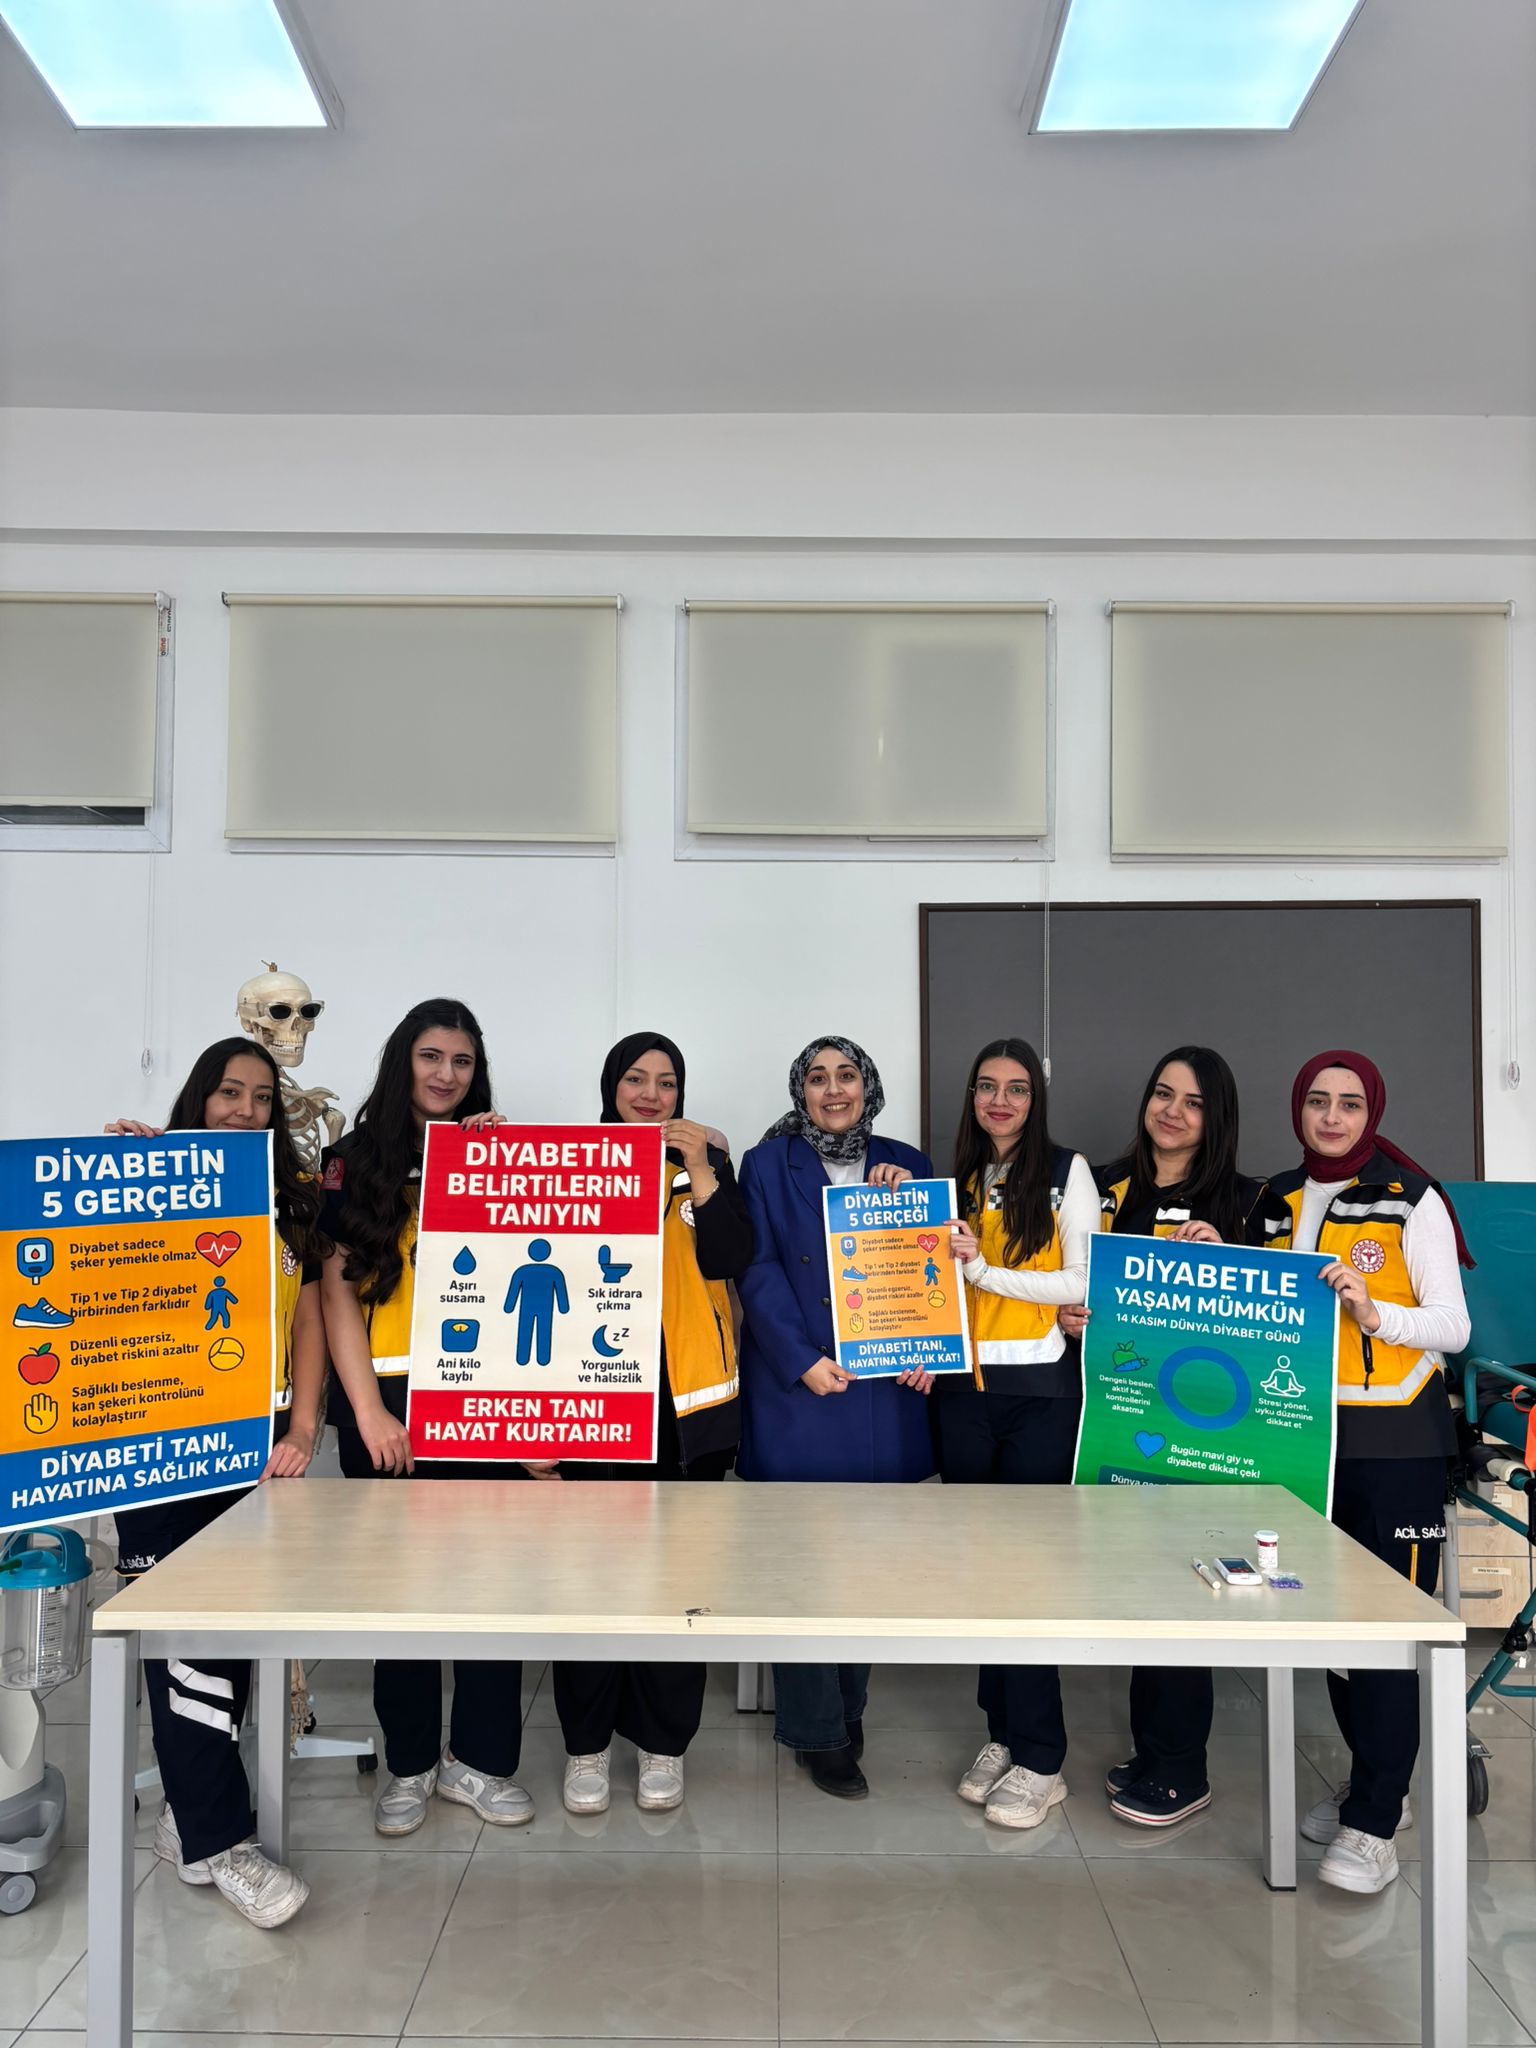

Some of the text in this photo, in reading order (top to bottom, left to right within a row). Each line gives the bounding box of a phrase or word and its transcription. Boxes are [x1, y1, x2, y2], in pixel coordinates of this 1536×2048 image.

[466, 1137, 632, 1167] DİYABETİN
[35, 1144, 225, 1183] DİYABETİN
[42, 1178, 221, 1218] 5 GERÇEĞİ
[845, 1188, 929, 1210] DİYABETİN
[486, 1203, 601, 1226] TANIYIN
[850, 1207, 928, 1227] 5 GERÇEĞİ
[69, 1237, 166, 1256] Diyabet sadece
[70, 1250, 197, 1271] şeker yemekle olmaz
[1124, 1253, 1298, 1298] DİYABETLE
[70, 1283, 197, 1307] Tip 1 ve Tip 2 diyabet
[449, 1280, 477, 1293] Aşırı
[588, 1288, 642, 1299] Sık idrara
[70, 1297, 190, 1318] birbirinden farklıdır
[440, 1293, 486, 1304] susama
[597, 1300, 631, 1312] çıkma
[1115, 1287, 1305, 1326] YAŞAM MÜMKÜN
[1116, 1313, 1300, 1344] 14 KASIM DÜNYA DİYABET GÜNÜ
[70, 1331, 175, 1352] Düzenli egzersiz,
[859, 1340, 946, 1355] DİYABETİ TANI,
[70, 1343, 199, 1367] diyabet riskini azaltır
[437, 1358, 481, 1369] Ani kilo
[849, 1352, 960, 1369] HAYATINA SAĞLIK KAT!
[441, 1371, 473, 1382] kaybı
[582, 1360, 640, 1373] Yorgunluk
[72, 1375, 184, 1399] Sağlıklı beslenme,
[578, 1372, 642, 1383] ve halsizlik
[1099, 1375, 1155, 1390] Dengeli beslen,
[72, 1385, 204, 1413] kan şekeri kontrolünü
[463, 1397, 604, 1418] ERKEN TANI
[1106, 1393, 1151, 1406] kontrollerini
[1258, 1398, 1309, 1412] Stresi yönet,
[72, 1408, 148, 1429] kolaylaştırır
[1112, 1405, 1144, 1415] aksatma
[1255, 1408, 1313, 1421] uyku düzenine
[425, 1422, 631, 1442] HAYAT KURTARIR!
[1266, 1418, 1292, 1428] dikkat
[41, 1431, 234, 1480] DİYABETİ TANI,
[1167, 1456, 1207, 1471] diyabete
[1209, 1462, 1239, 1475] dikkat
[1170, 1445, 1254, 1466] Bugün mavi giy ve
[11, 1450, 259, 1509] HAYATINA SAĞLIK KAT!
[1394, 1525, 1420, 1539] ACİL
[127, 1554, 157, 1568] SAĞLIK
